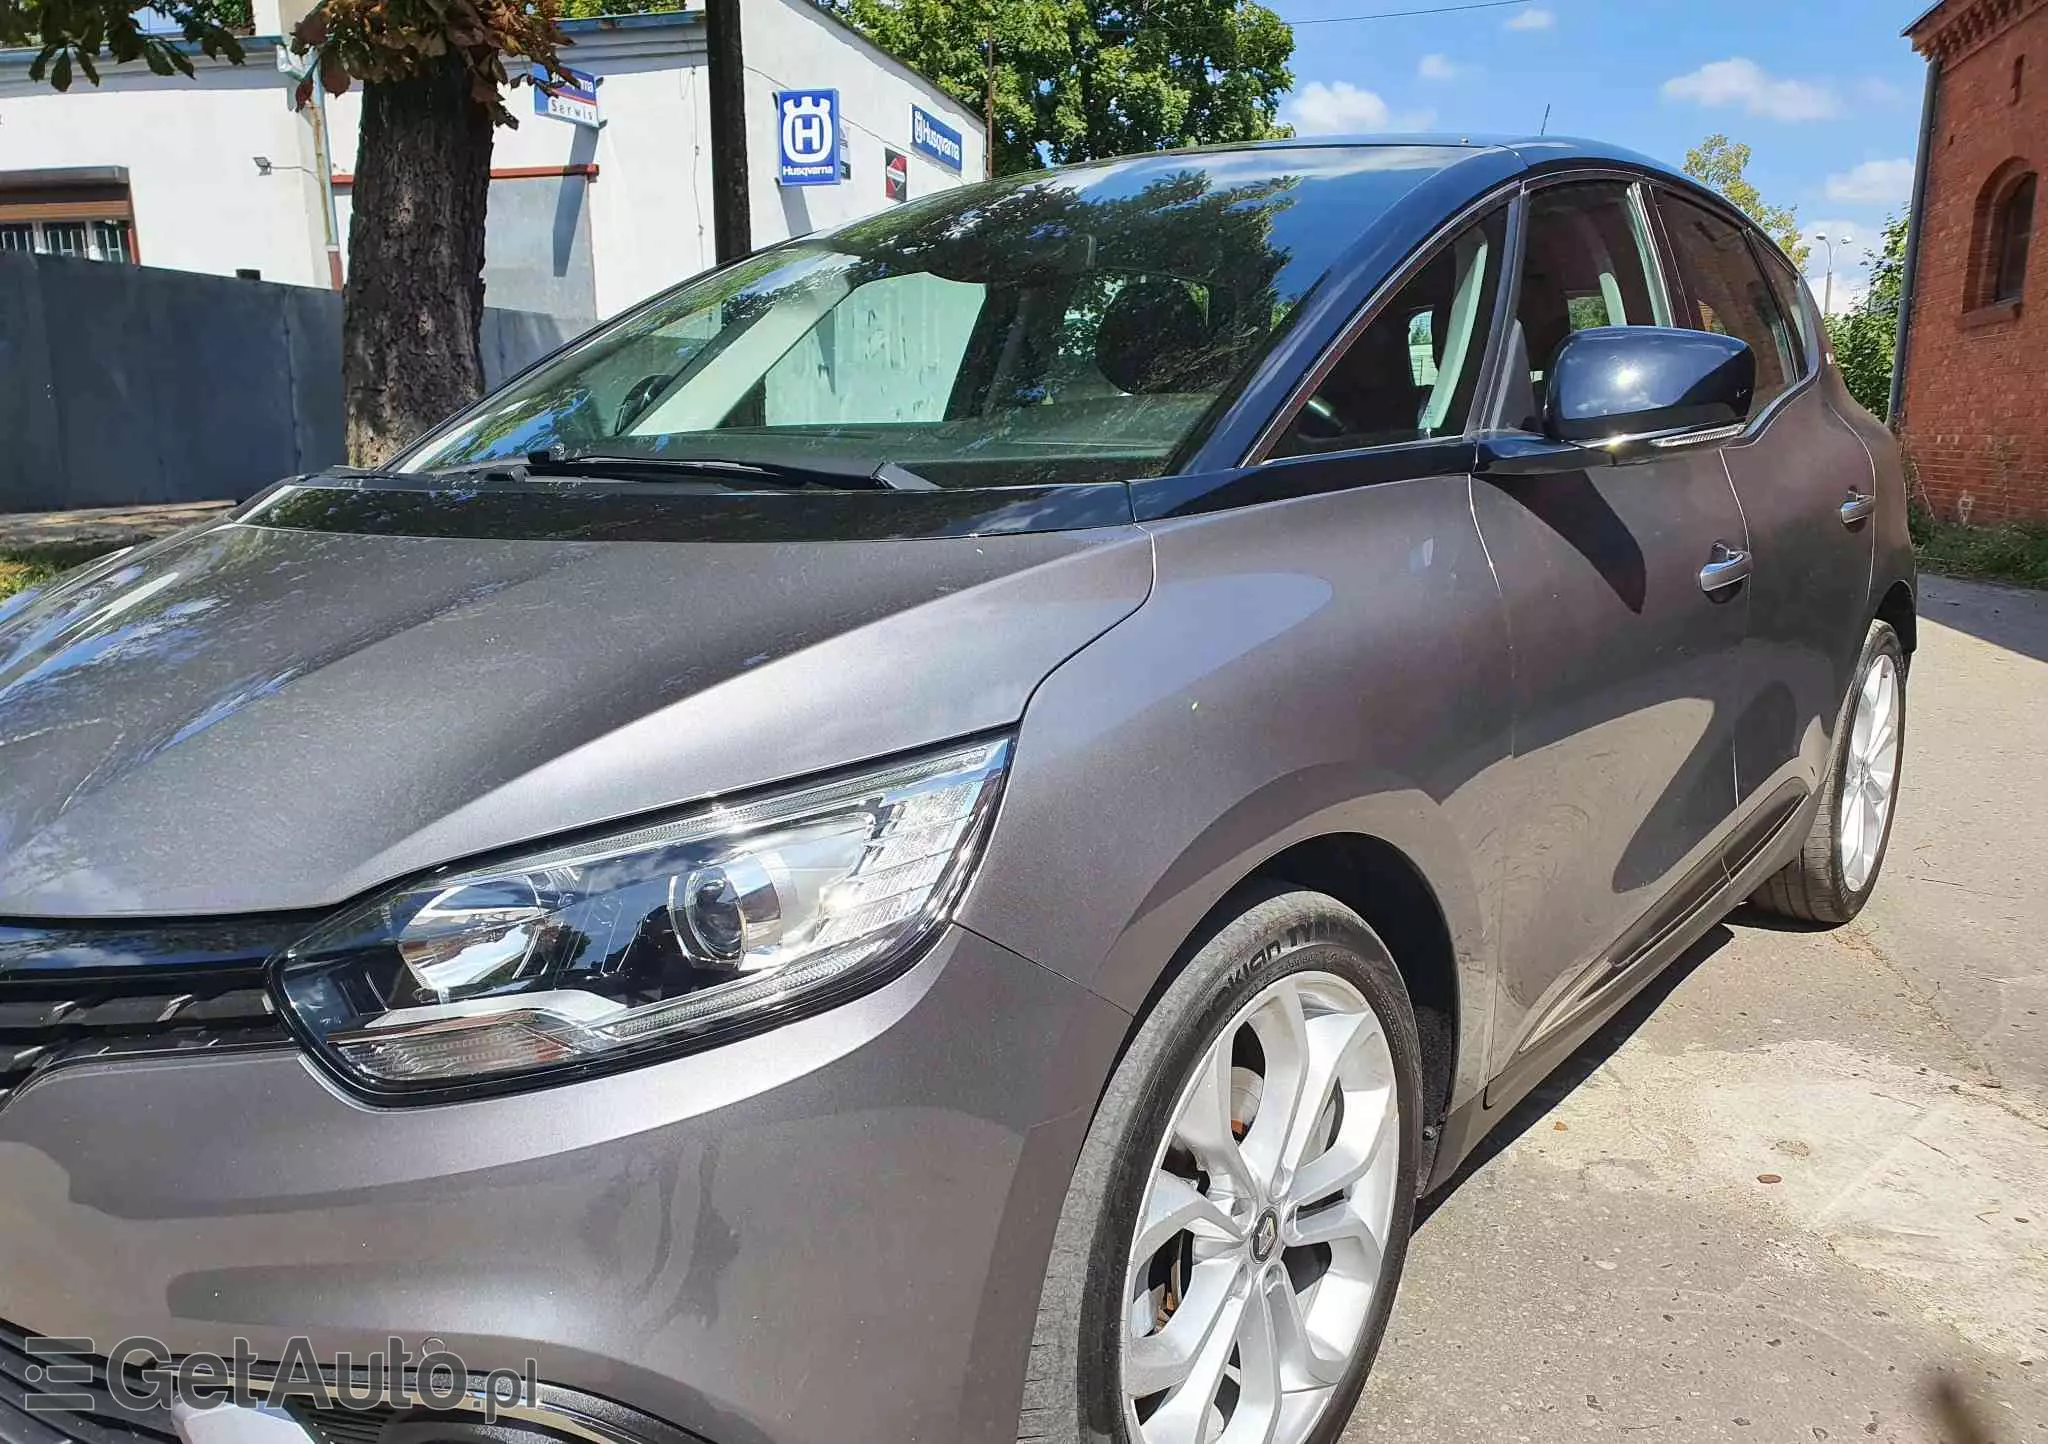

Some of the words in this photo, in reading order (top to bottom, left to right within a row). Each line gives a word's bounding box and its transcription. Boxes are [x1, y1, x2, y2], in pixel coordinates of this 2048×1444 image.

[551, 99, 594, 120] Serwis
[923, 119, 960, 161] Husqvarna
[782, 165, 834, 177] Husqvarna
